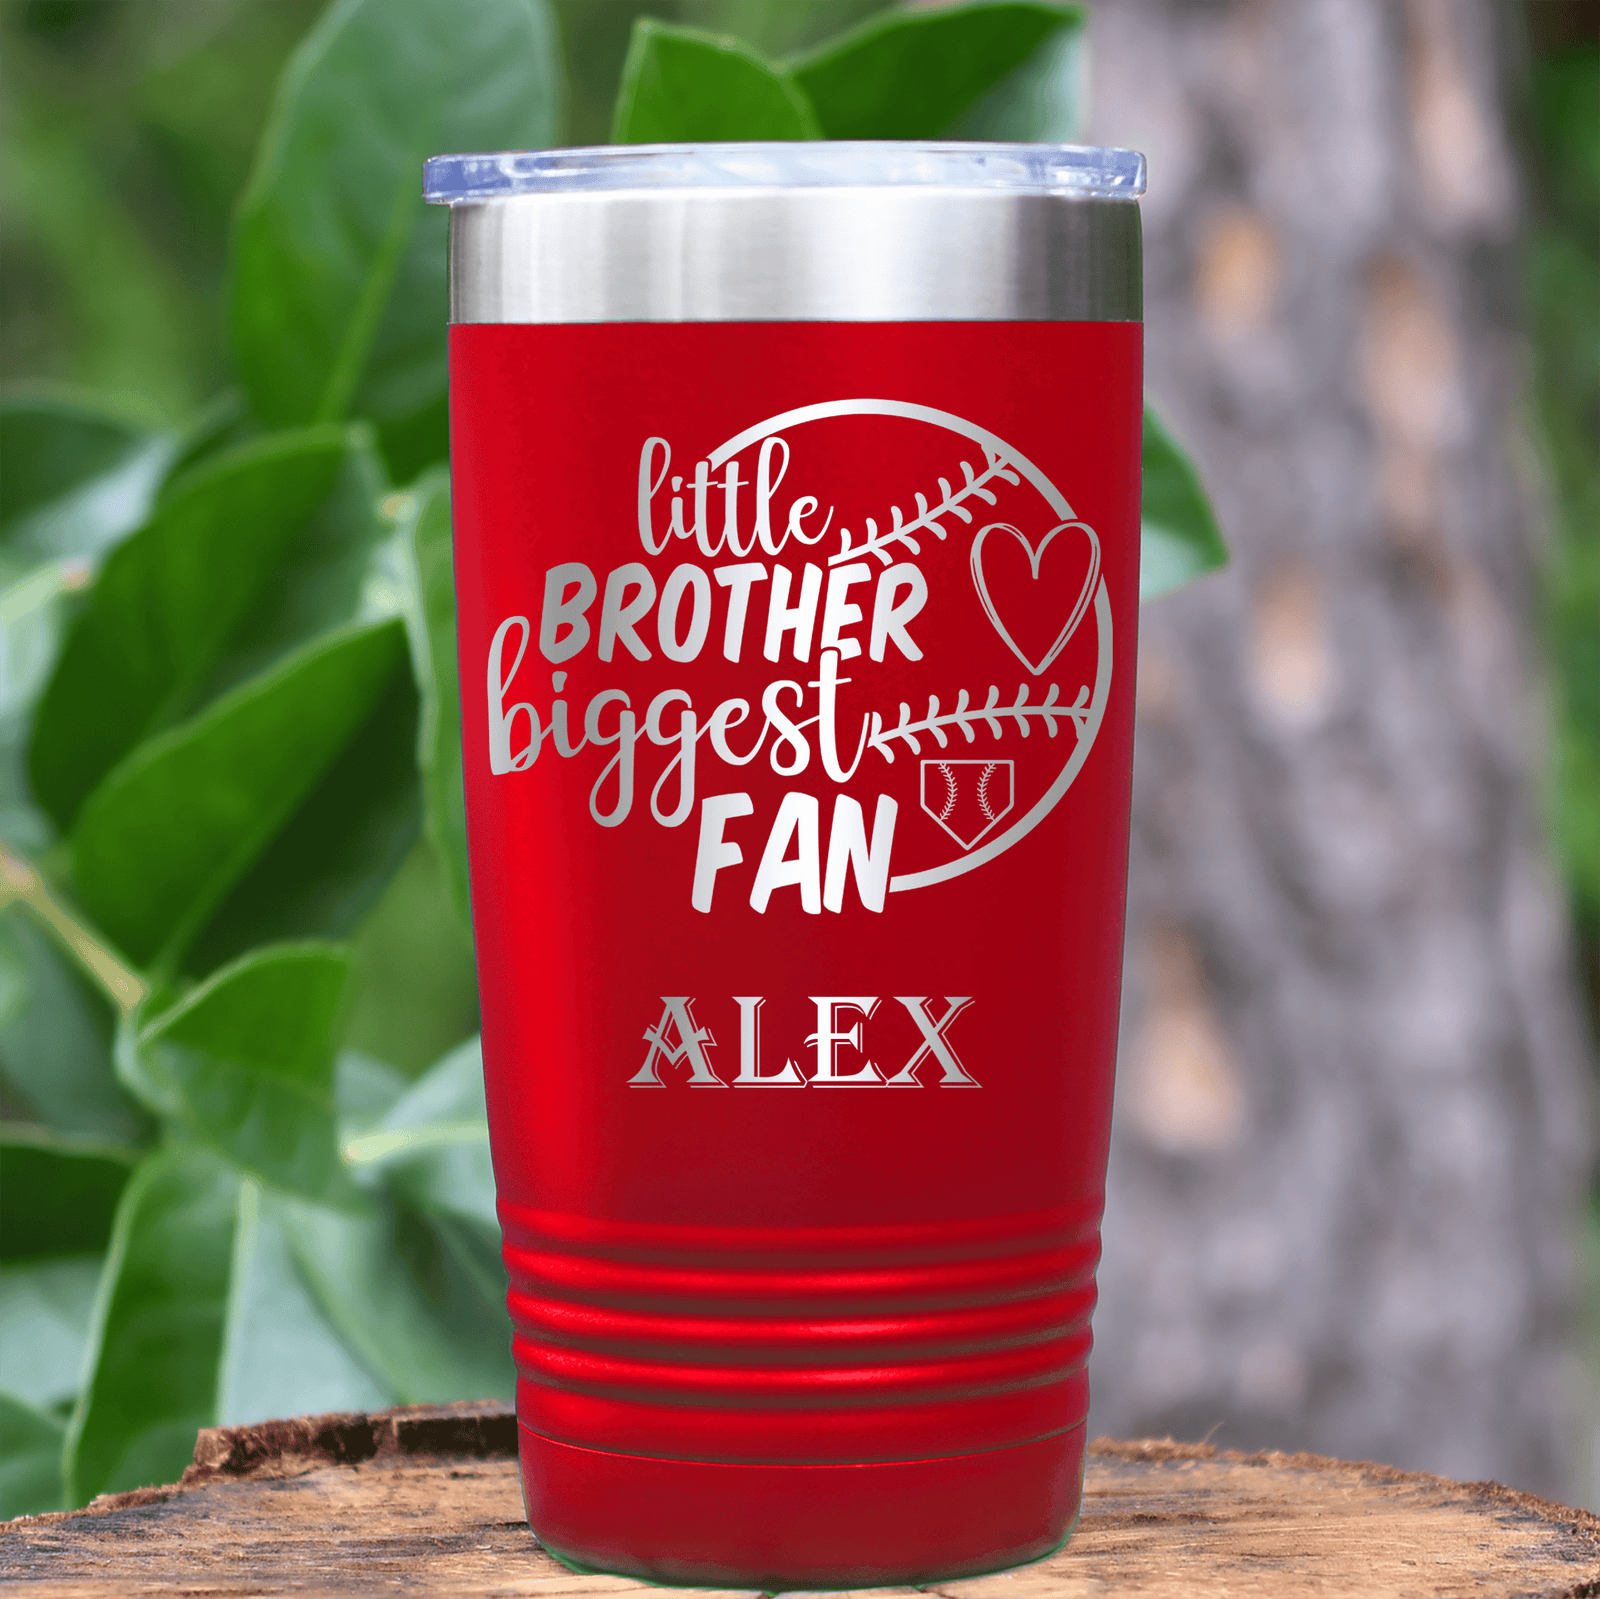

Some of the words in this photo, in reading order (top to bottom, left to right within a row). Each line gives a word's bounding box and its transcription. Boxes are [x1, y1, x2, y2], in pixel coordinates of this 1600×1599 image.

[638, 437, 834, 557] little
[540, 563, 928, 664] BROTHER
[487, 616, 870, 827] biggest
[692, 792, 898, 914] FAN
[626, 997, 983, 1088] ALEX
